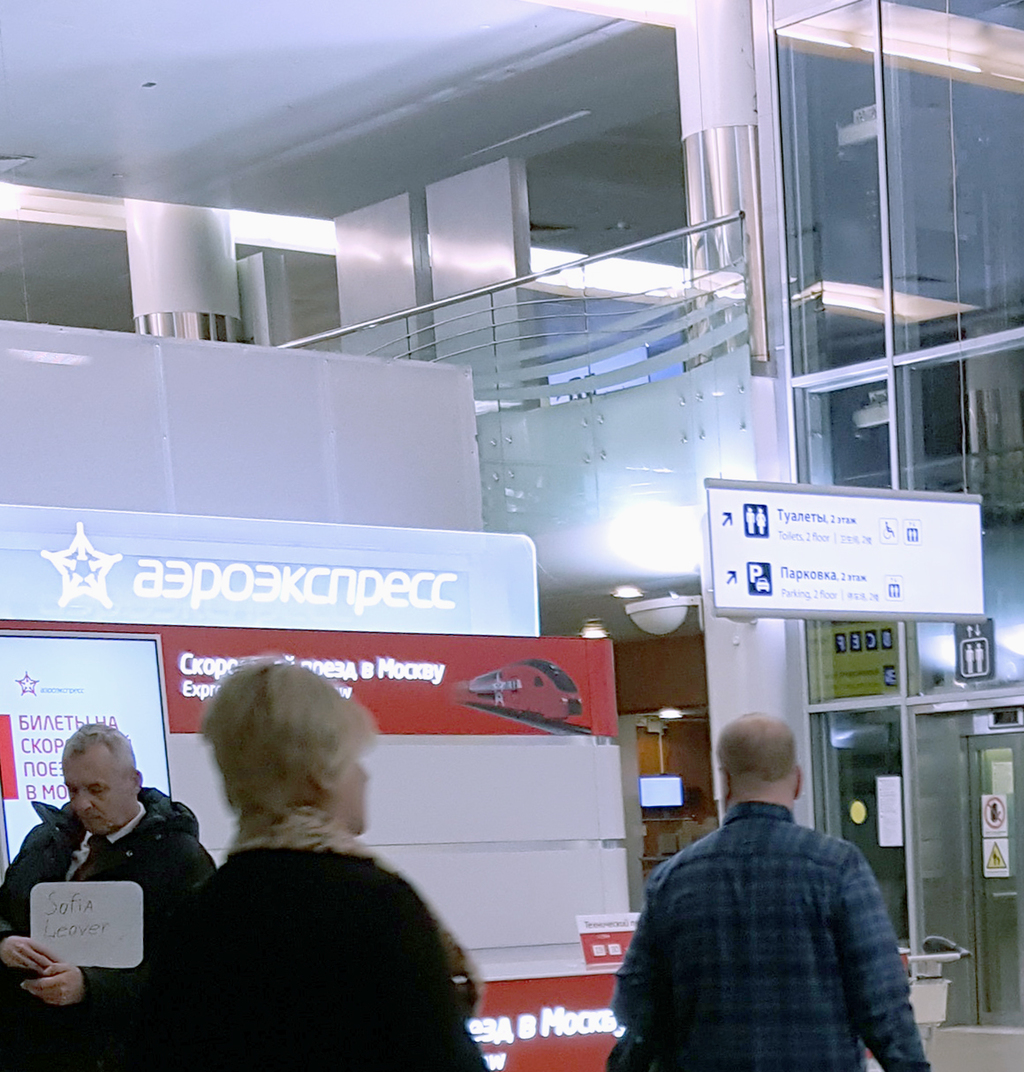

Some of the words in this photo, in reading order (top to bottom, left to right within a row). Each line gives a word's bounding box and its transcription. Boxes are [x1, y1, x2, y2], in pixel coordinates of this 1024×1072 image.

[777, 508, 828, 524] Туалеты,
[830, 514, 835, 523] 2
[837, 516, 857, 524] этаж
[780, 566, 839, 583] Парковка,
[841, 572, 846, 581] 2
[847, 574, 867, 582] этаж
[133, 558, 458, 616] аэроэкспресс
[361, 660, 374, 679] в
[377, 656, 446, 684] Москву
[26, 784, 37, 800] В
[517, 1013, 536, 1039] в
